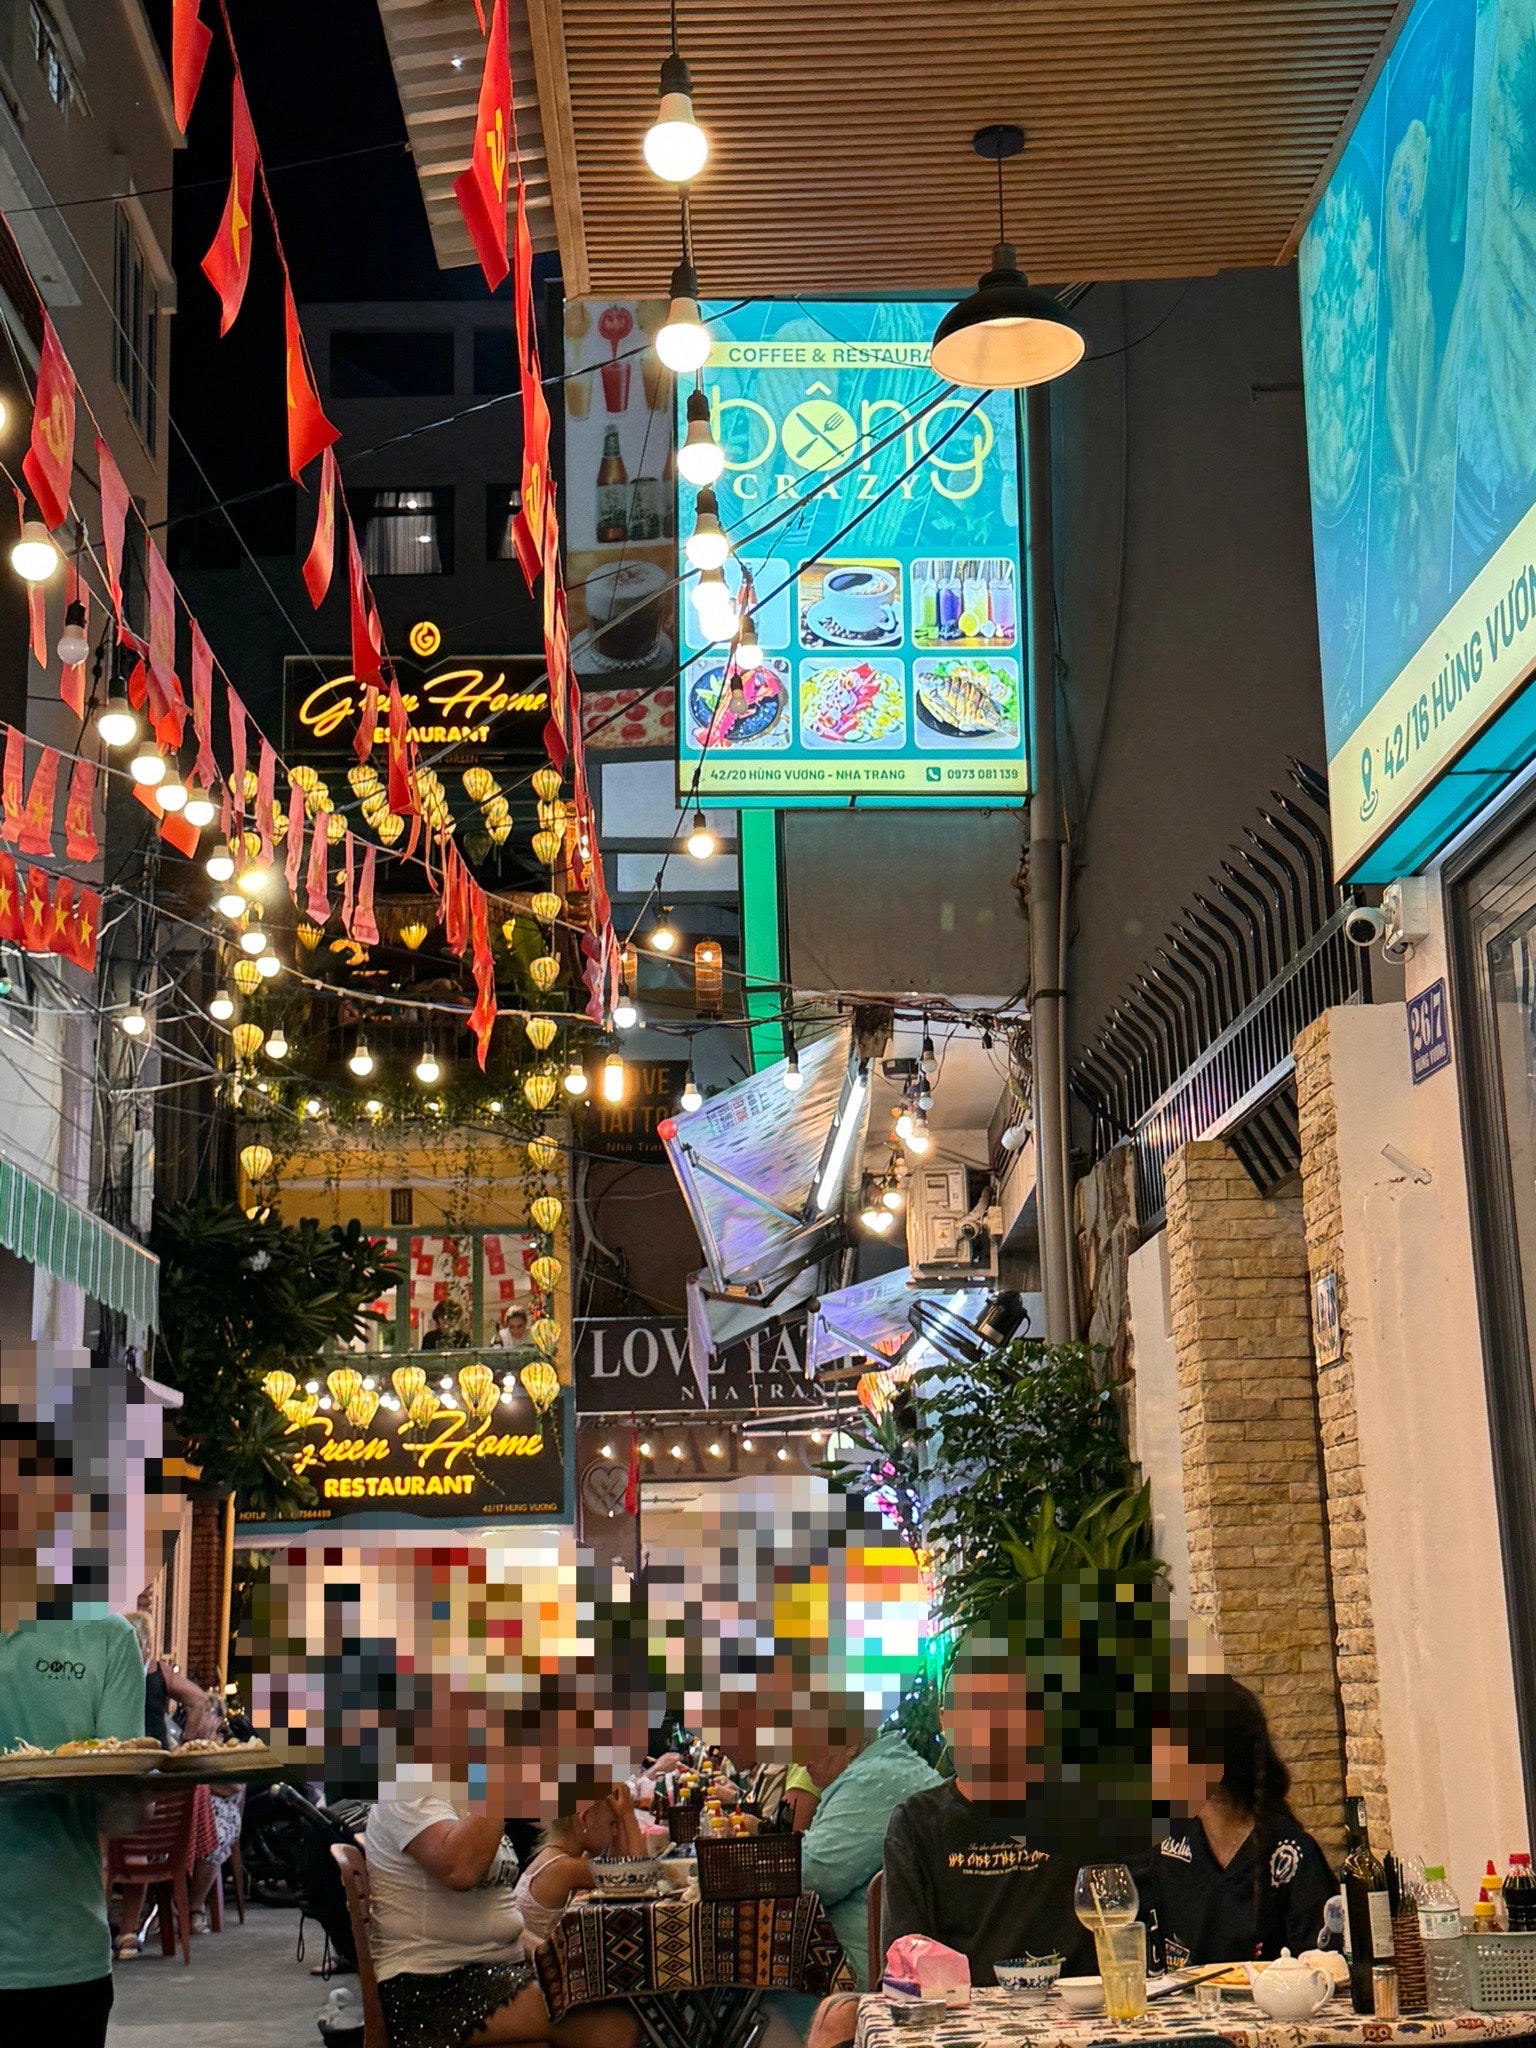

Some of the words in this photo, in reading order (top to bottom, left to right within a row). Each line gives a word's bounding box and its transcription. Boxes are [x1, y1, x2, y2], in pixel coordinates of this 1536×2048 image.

[728, 347, 806, 363] COFFEE
[812, 347, 826, 363] &
[833, 347, 932, 364] RESTAURA
[732, 473, 921, 501] CRAZY
[372, 725, 490, 744] ESAURANT
[1383, 694, 1430, 780] 42/16
[710, 769, 747, 781] 42/20
[835, 769, 862, 781] NHA
[865, 769, 906, 781] TRANG
[947, 769, 975, 780] 0973
[977, 769, 998, 780] 081
[999, 769, 1019, 780] 139
[1410, 991, 1442, 1052] 26/7
[397, 1409, 544, 1470] Home
[324, 1475, 476, 1498] RESTAURANT
